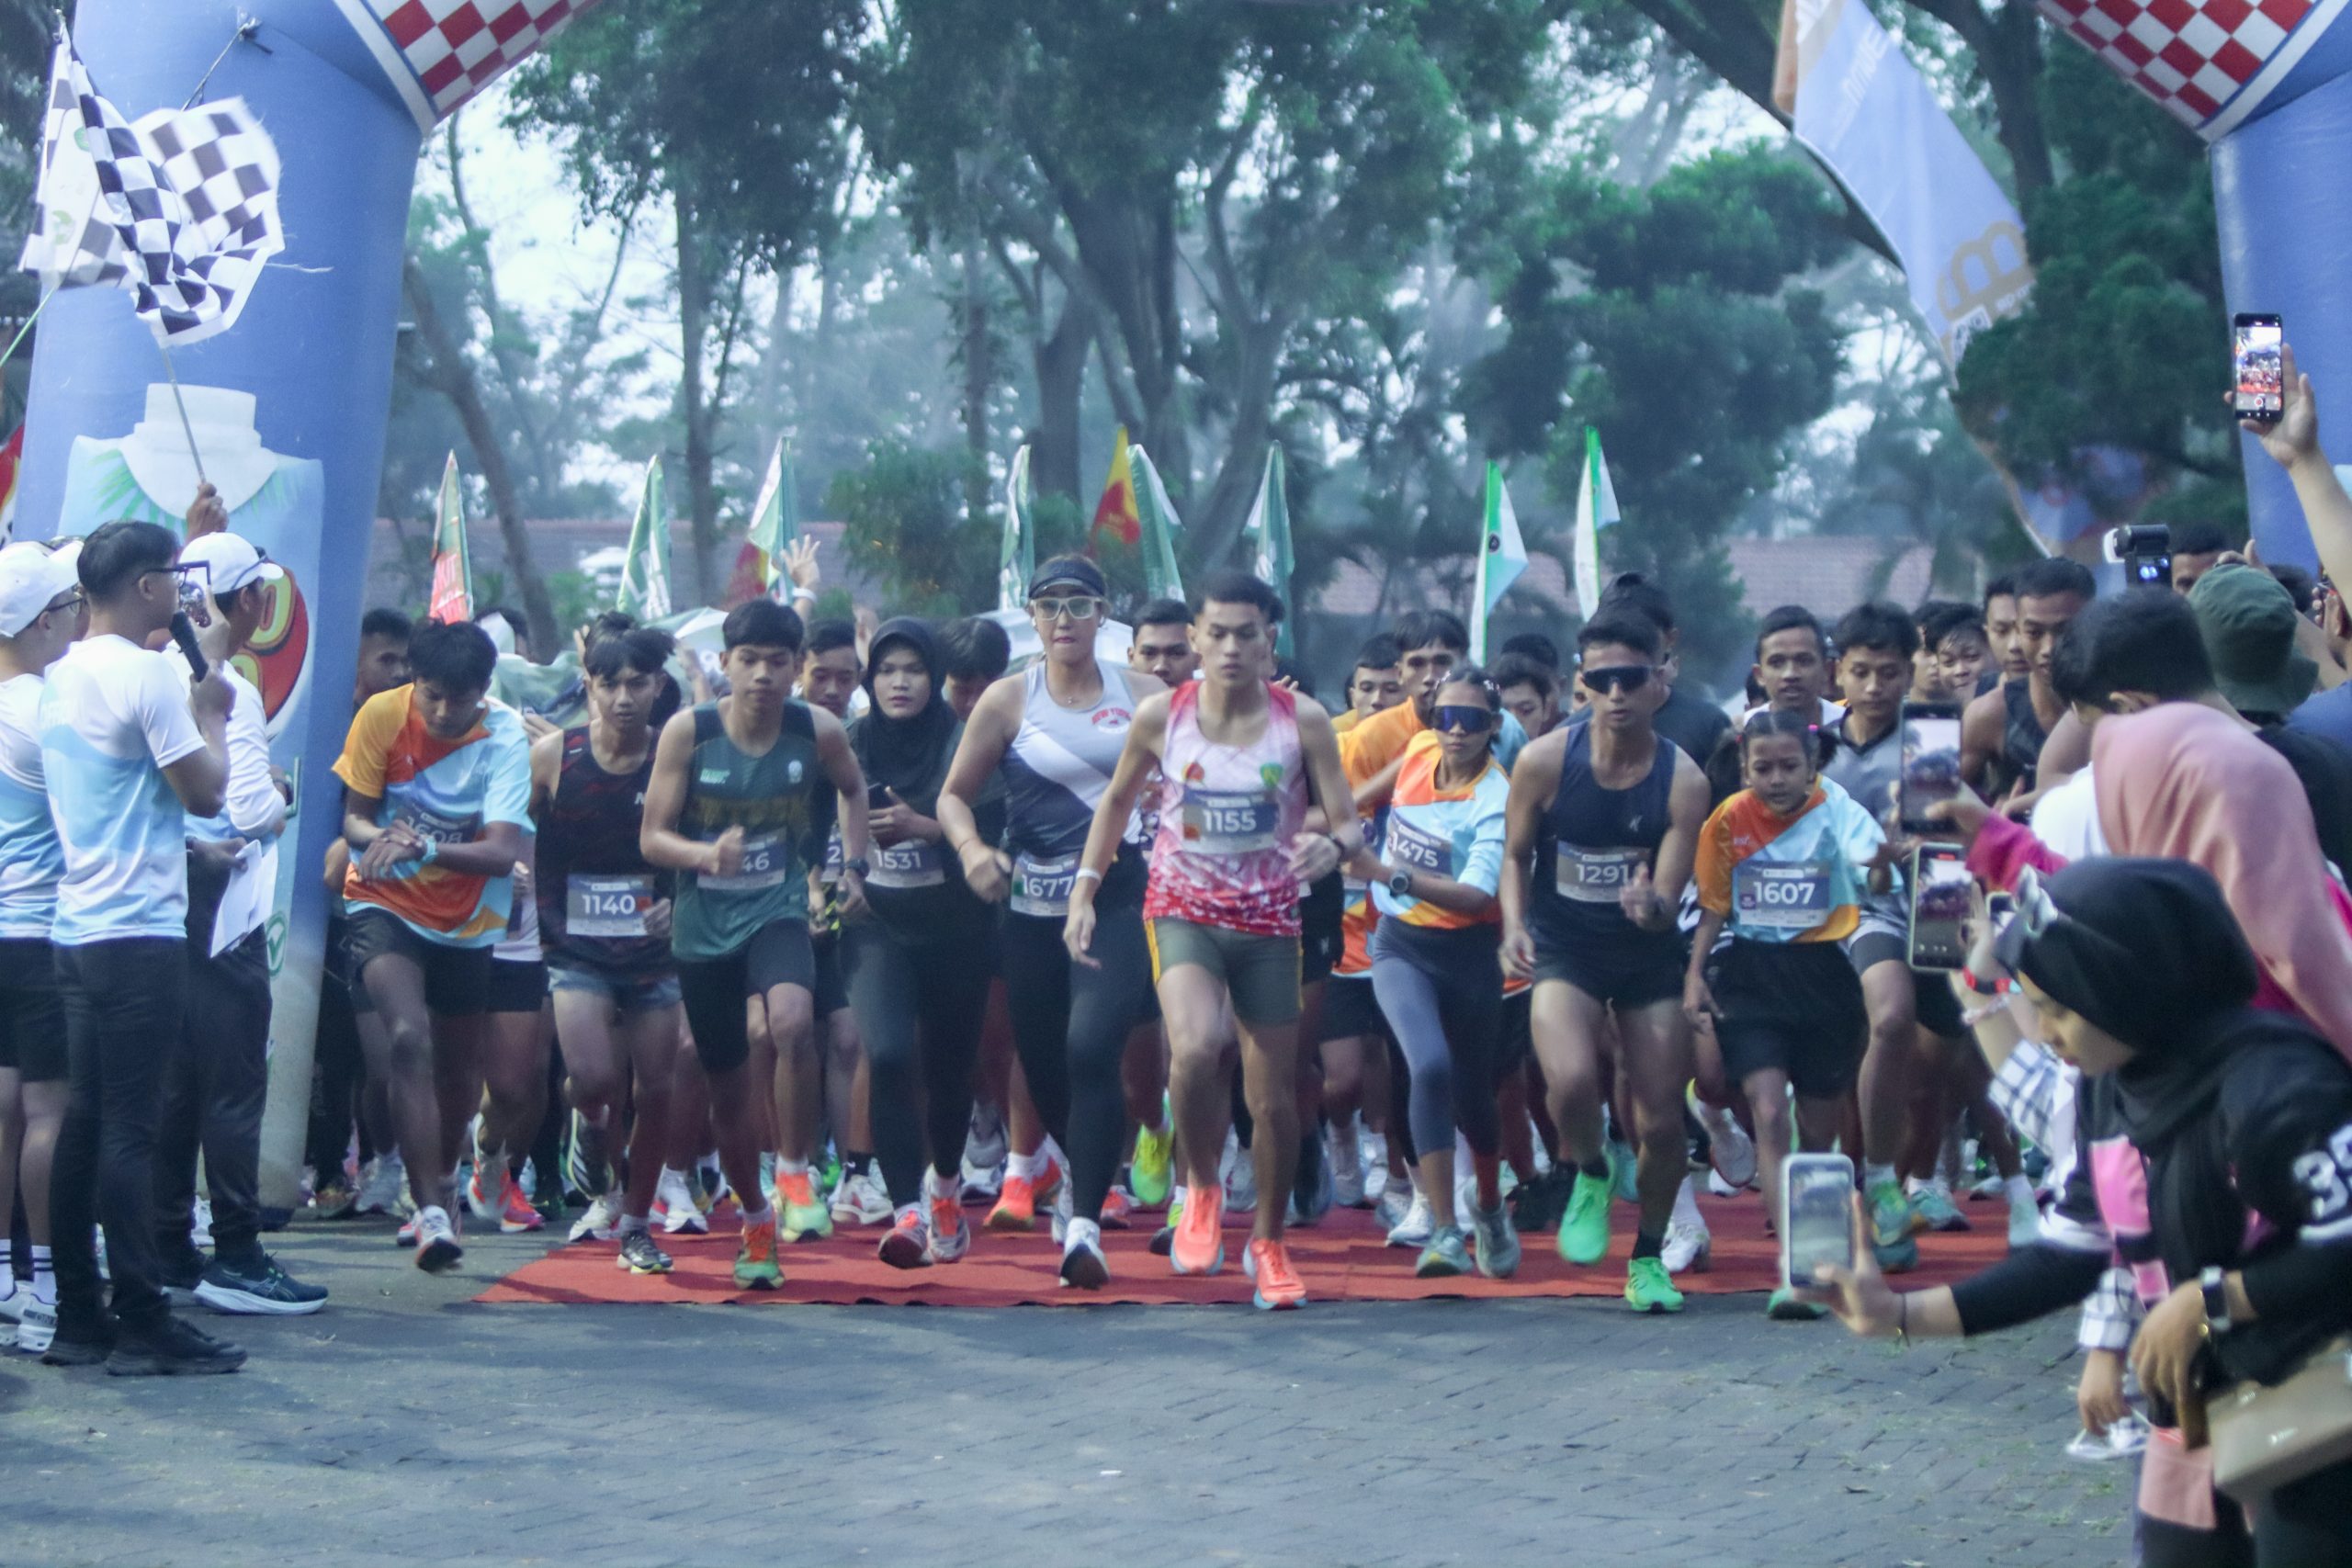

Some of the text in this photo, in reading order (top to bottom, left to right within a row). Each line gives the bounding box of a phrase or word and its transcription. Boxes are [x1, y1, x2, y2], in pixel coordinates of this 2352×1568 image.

[1203, 809, 1257, 832] 1155
[874, 849, 922, 870] 1531
[1392, 830, 1439, 868] 1475
[1021, 874, 1074, 897] 1677
[1576, 863, 1630, 885] 1291
[582, 894, 636, 915] 1140
[1753, 882, 1815, 905] 1607
